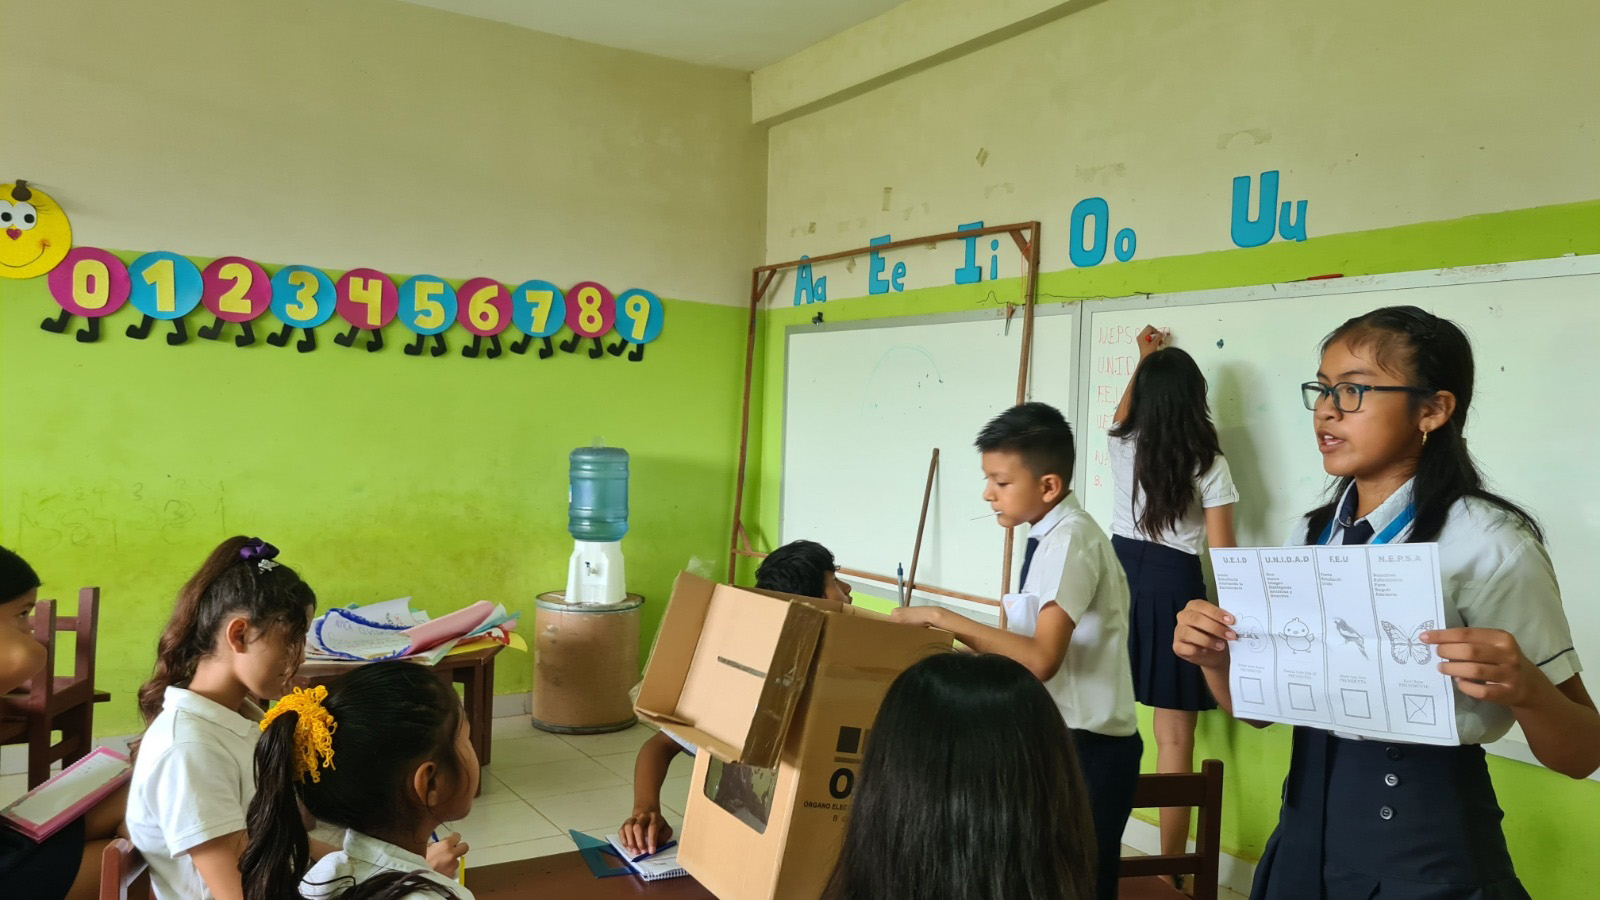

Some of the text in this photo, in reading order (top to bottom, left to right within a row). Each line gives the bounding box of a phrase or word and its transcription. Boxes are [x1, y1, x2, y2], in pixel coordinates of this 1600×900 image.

[1231, 171, 1308, 248] Uu
[1069, 197, 1137, 268] Oo
[73, 259, 651, 340] 0 1 2 3 4 5 6 7 8 9
[1222, 556, 1248, 564] U.E.I.D
[1264, 555, 1310, 564] U.N.I.D.A.D
[1328, 555, 1349, 563] F.E.U
[1377, 554, 1422, 563] N.E.P.S.A
